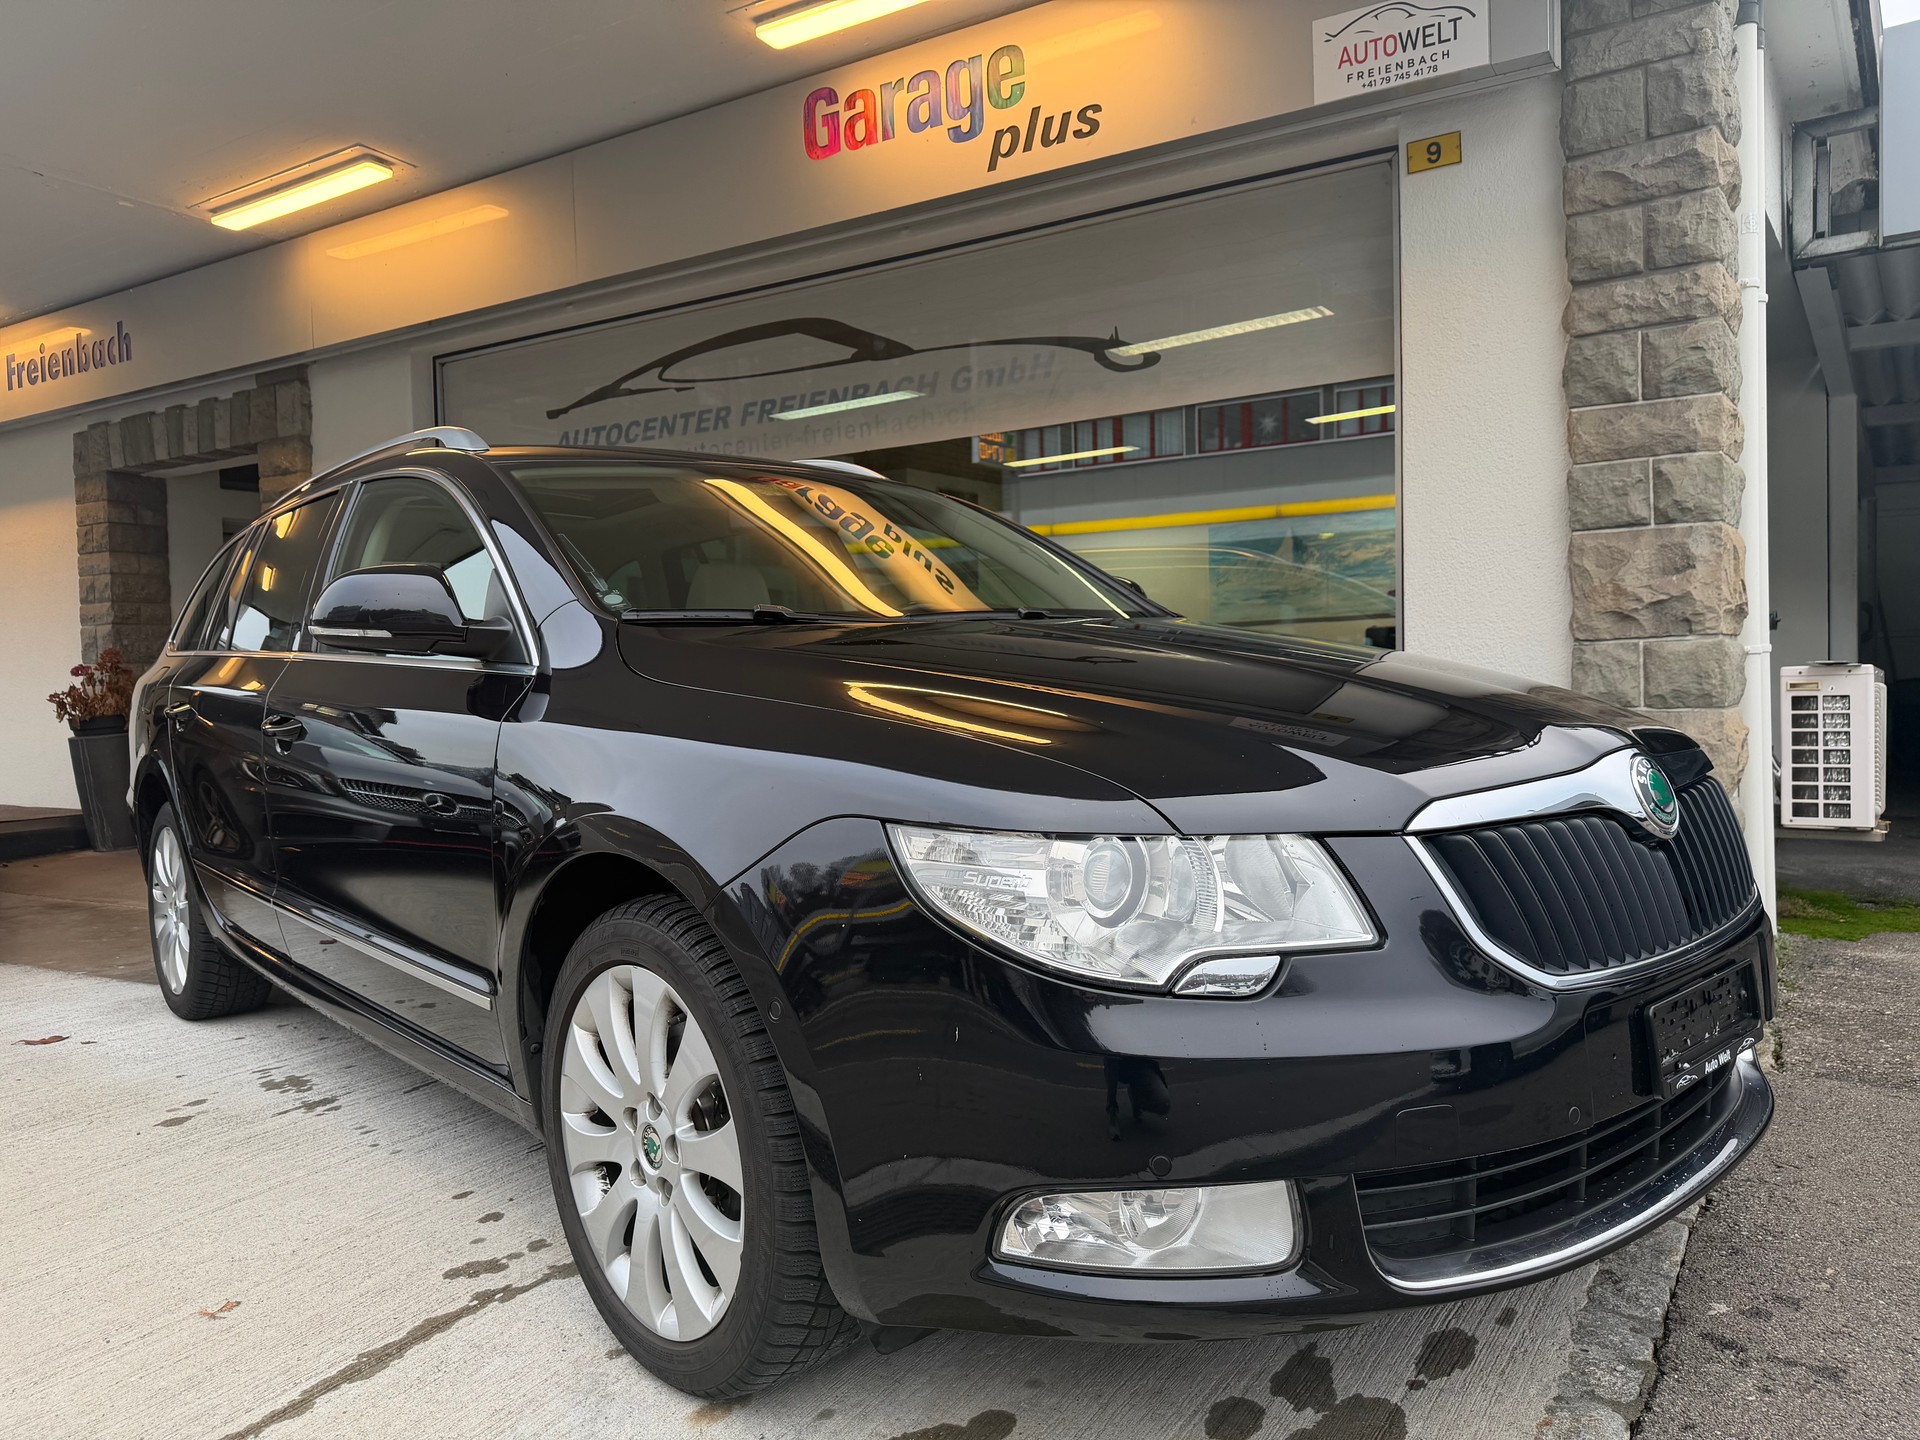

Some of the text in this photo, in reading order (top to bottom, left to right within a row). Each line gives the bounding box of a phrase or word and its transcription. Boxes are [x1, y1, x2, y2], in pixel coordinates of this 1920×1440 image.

[1337, 16, 1463, 69] AUTOWELT
[1346, 49, 1450, 83] FREIENBACH
[1361, 65, 1438, 89] +41 79 745 41 78
[803, 44, 1026, 161] Garage
[987, 103, 1103, 173] plus
[1426, 141, 1442, 164] 9
[6, 320, 133, 391] Freienbach
[558, 405, 730, 446] AUTOCENTER
[950, 351, 1057, 393] GmbH
[962, 871, 1033, 891] Superb
[1704, 1049, 1731, 1075] Auto Welt
